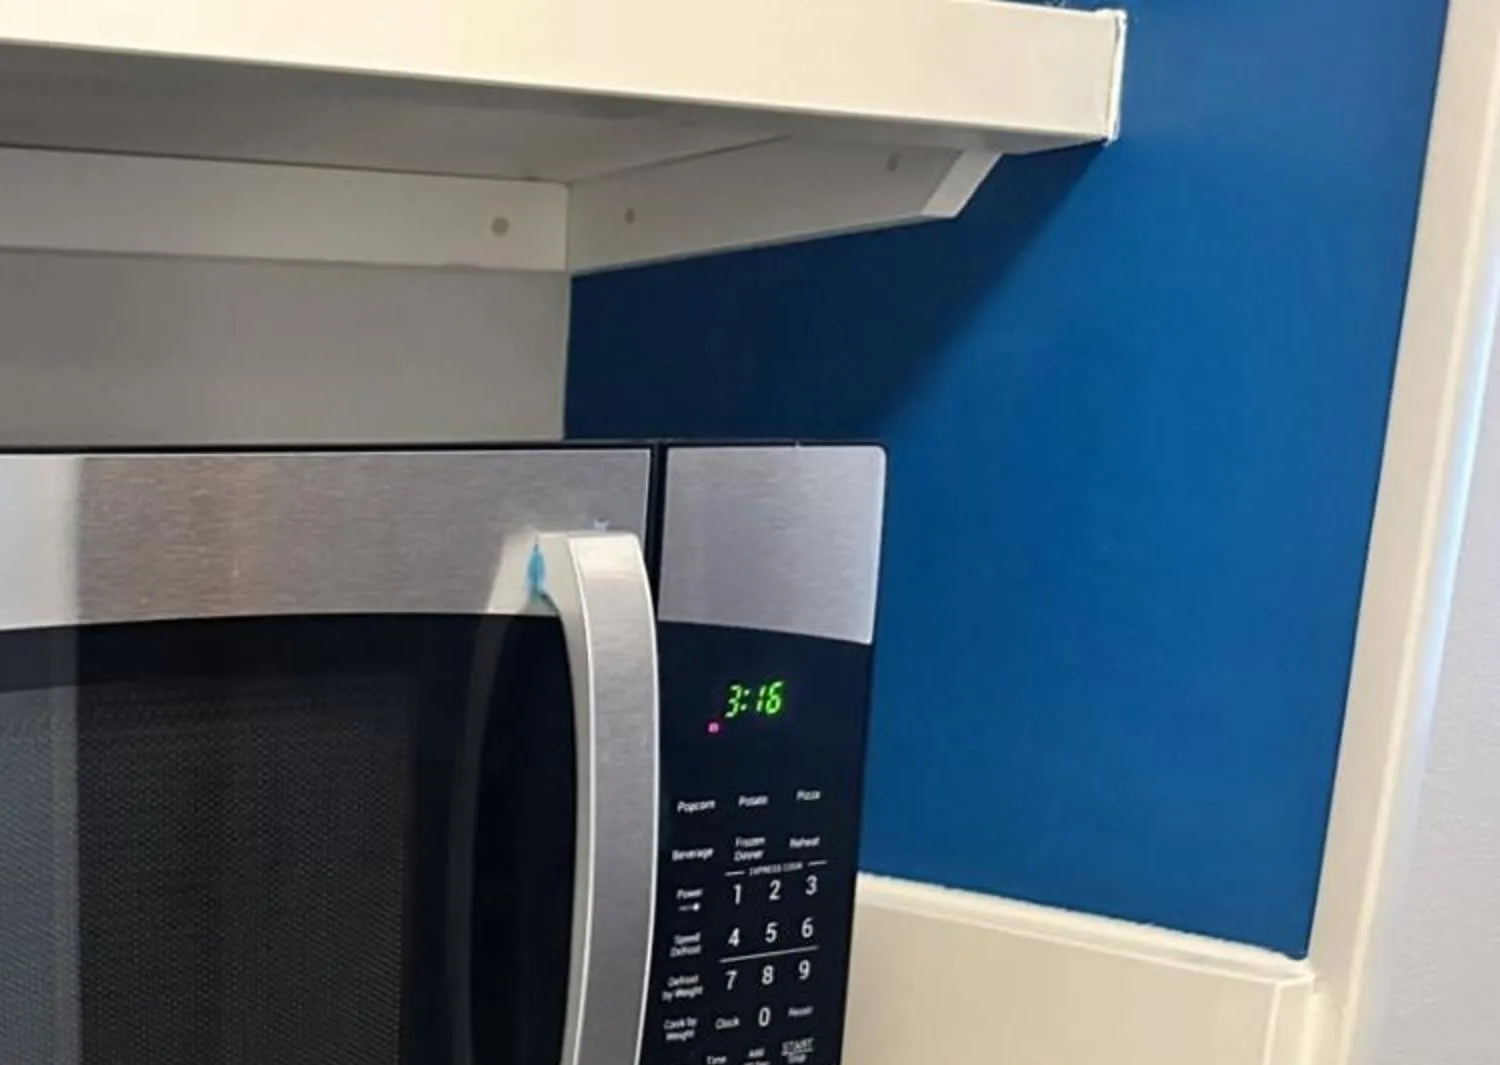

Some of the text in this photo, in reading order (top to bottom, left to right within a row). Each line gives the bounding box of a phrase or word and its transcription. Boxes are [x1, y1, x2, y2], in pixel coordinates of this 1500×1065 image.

[725, 680, 784, 718] 3:16
[738, 795, 769, 807] Potato
[796, 790, 821, 801] Pizza
[677, 799, 716, 813] Popcorn
[789, 836, 821, 849] Reheat
[672, 847, 714, 862] Beverage
[676, 888, 704, 900] Power
[732, 874, 818, 905] 1 2 3
[728, 916, 814, 947] 4 5 6
[725, 959, 811, 991] 7 8 9
[715, 1016, 740, 1030] Clock
[758, 1006, 772, 1028] 0
